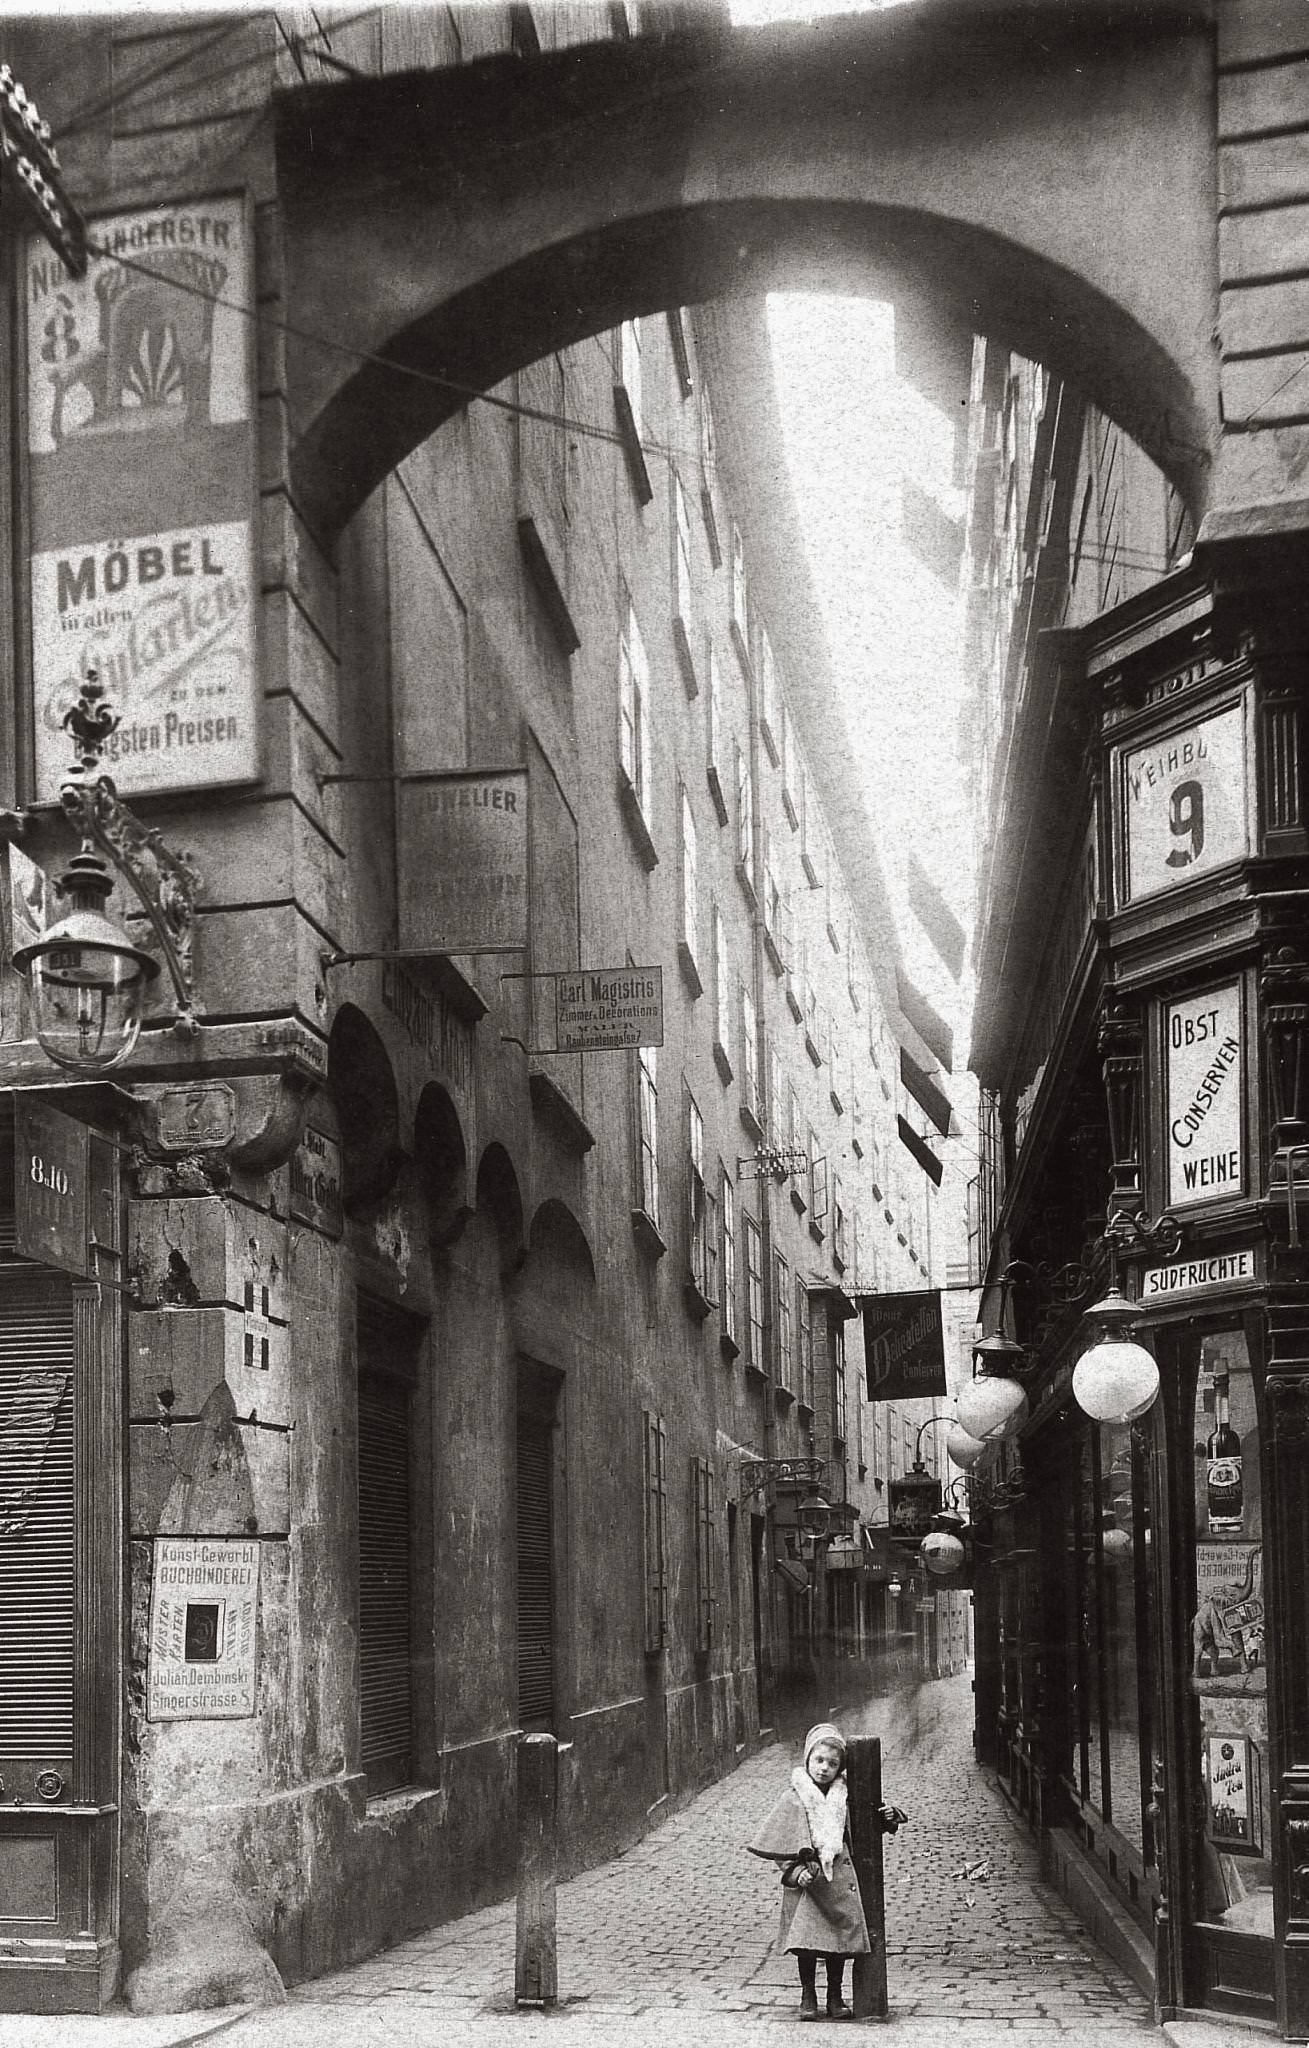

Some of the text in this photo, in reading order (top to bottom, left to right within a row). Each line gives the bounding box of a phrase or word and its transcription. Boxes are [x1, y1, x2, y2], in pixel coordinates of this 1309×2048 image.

[56, 537, 225, 614] MÖBEL
[1165, 780, 1204, 869] 9
[559, 976, 655, 1008] Carl Magistris
[599, 1005, 658, 1021] Decorations
[1171, 1009, 1220, 1049] OBST
[1171, 1035, 1240, 1149] CONSERVEN
[1182, 1151, 1239, 1190] WEINE
[160, 1566, 251, 1586] BUCHBINDEREI
[153, 1599, 170, 1662] MUSTER
[168, 1605, 185, 1664] KARTEN
[152, 1669, 188, 1687] Julian
[152, 1690, 237, 1711] Singerstrasse
